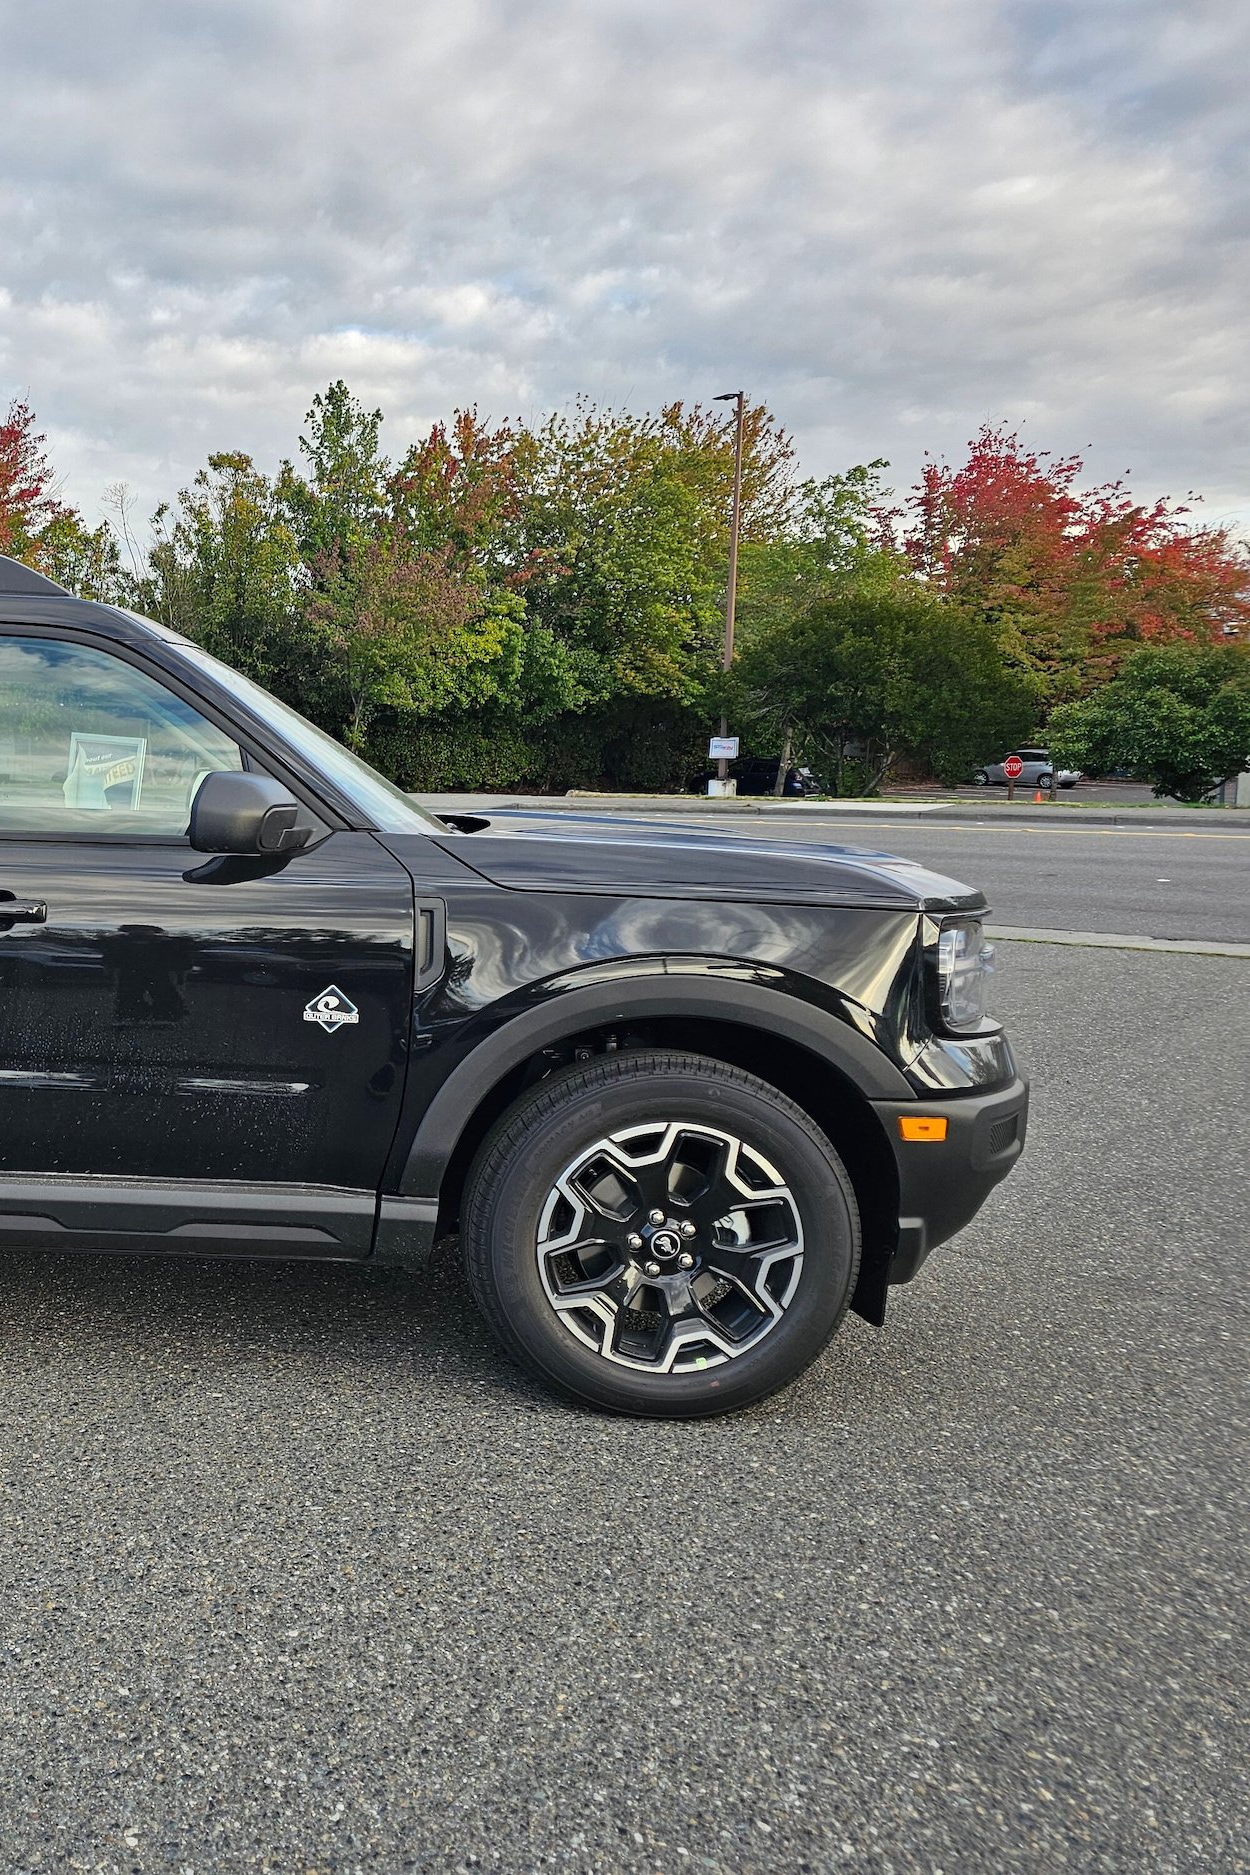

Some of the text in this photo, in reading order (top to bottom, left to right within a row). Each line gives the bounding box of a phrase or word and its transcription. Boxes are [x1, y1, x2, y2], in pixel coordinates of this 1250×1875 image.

[1006, 763, 1021, 771] STOP
[306, 1012, 356, 1022] OUTER BANKS
